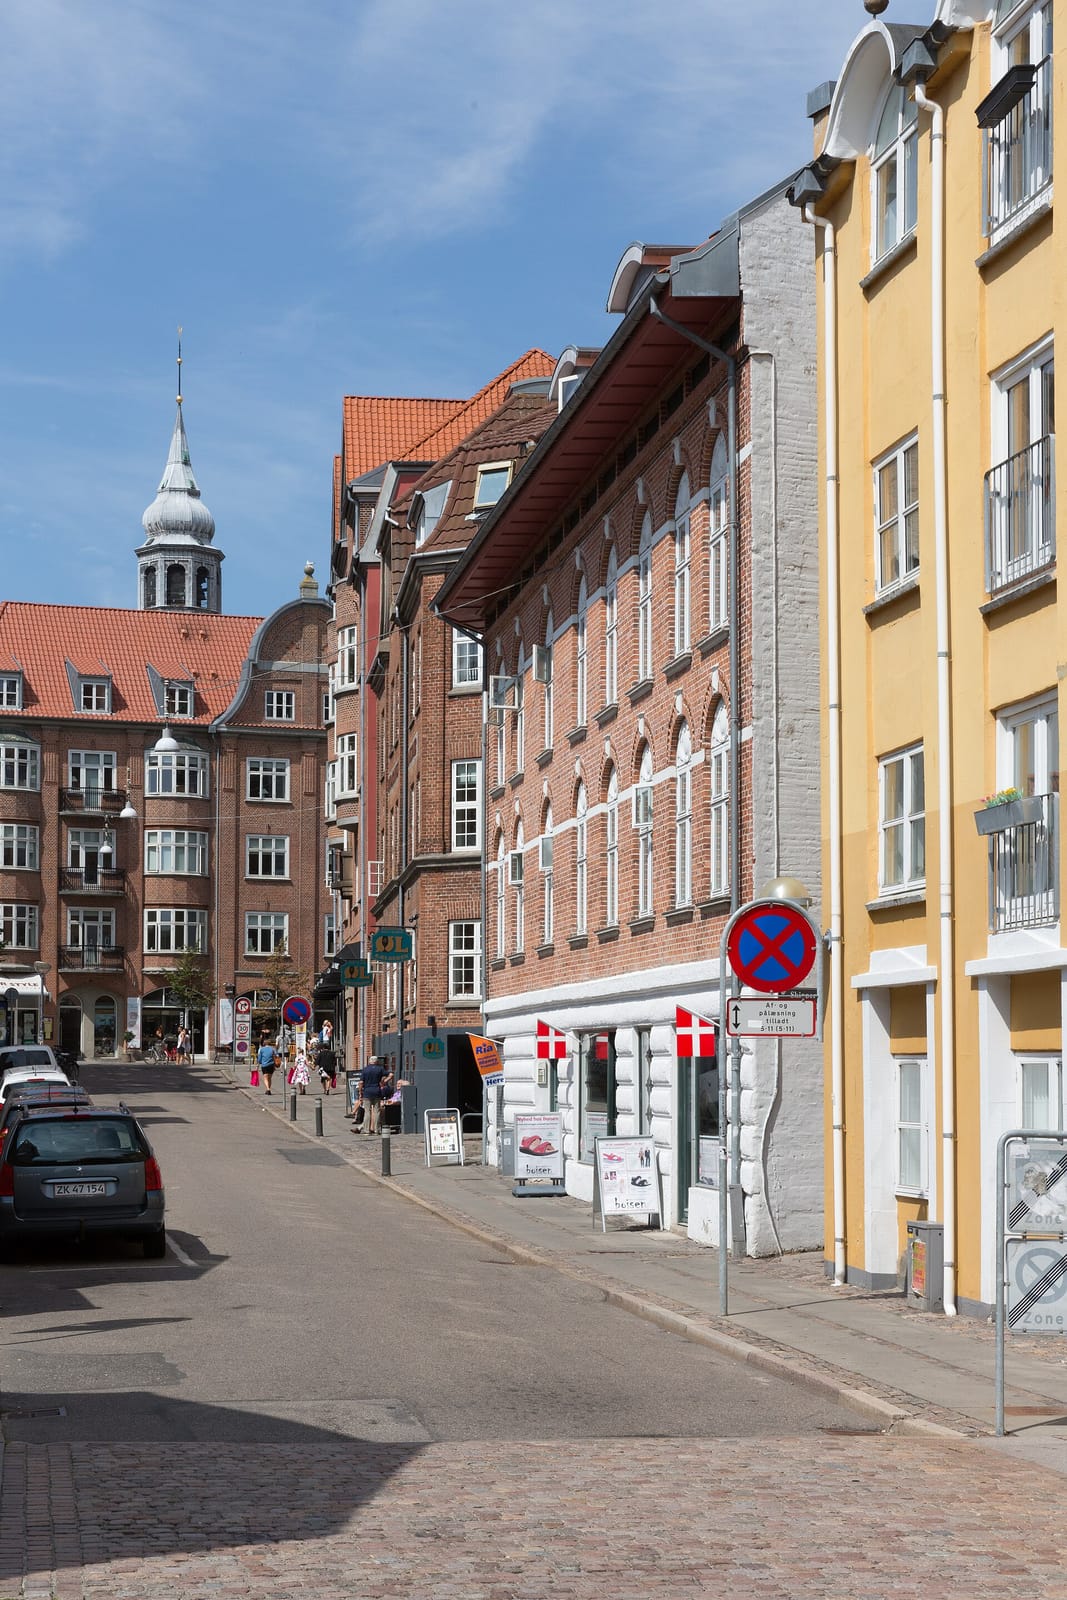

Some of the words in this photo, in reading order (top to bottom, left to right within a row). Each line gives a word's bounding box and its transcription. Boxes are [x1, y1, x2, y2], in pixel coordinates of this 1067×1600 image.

[375, 936, 409, 952] ØL
[475, 1043, 493, 1054] Ria
[486, 1077, 505, 1086] Here
[57, 1184, 70, 1194] ZK
[72, 1184, 84, 1194] 47
[87, 1183, 104, 1194] 154
[1024, 1212, 1062, 1224] Zone
[1023, 1311, 1064, 1324] Zone
